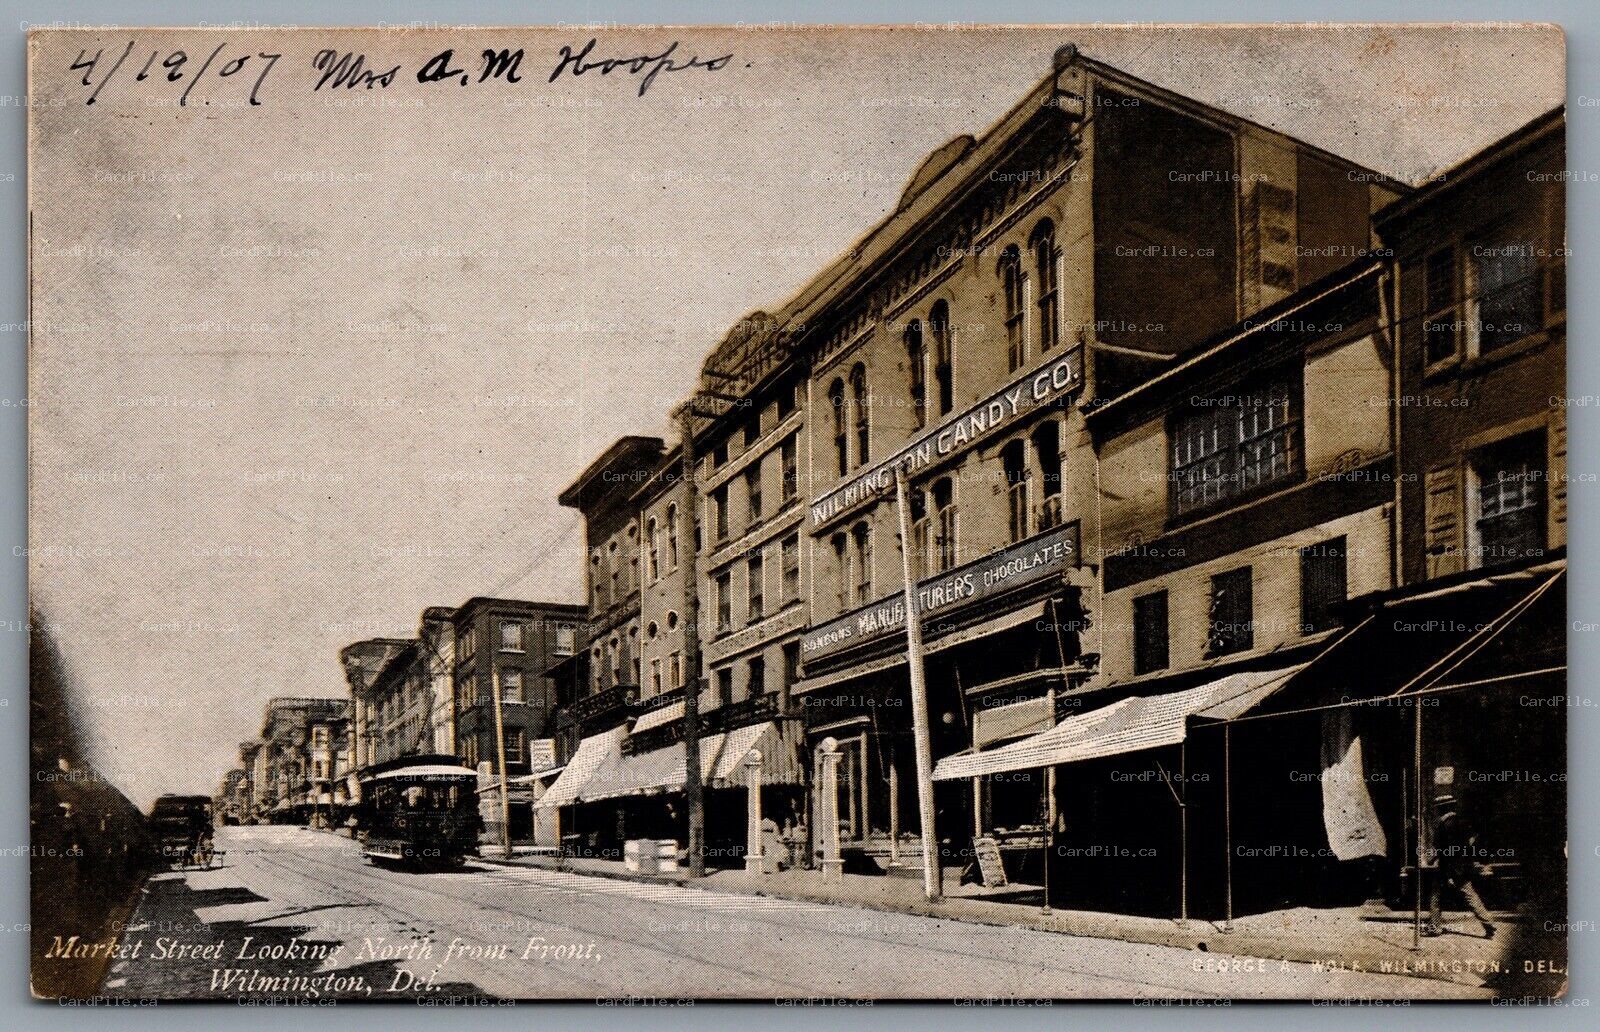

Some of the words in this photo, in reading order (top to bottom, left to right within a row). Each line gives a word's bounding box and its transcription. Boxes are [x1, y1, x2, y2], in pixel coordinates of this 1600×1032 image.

[313, 49, 401, 91] Mrs
[811, 443, 931, 526] WILMINGTON
[937, 390, 1021, 455] CANDY
[1032, 361, 1080, 401] CO.
[983, 539, 1073, 588] CHOCOLATES
